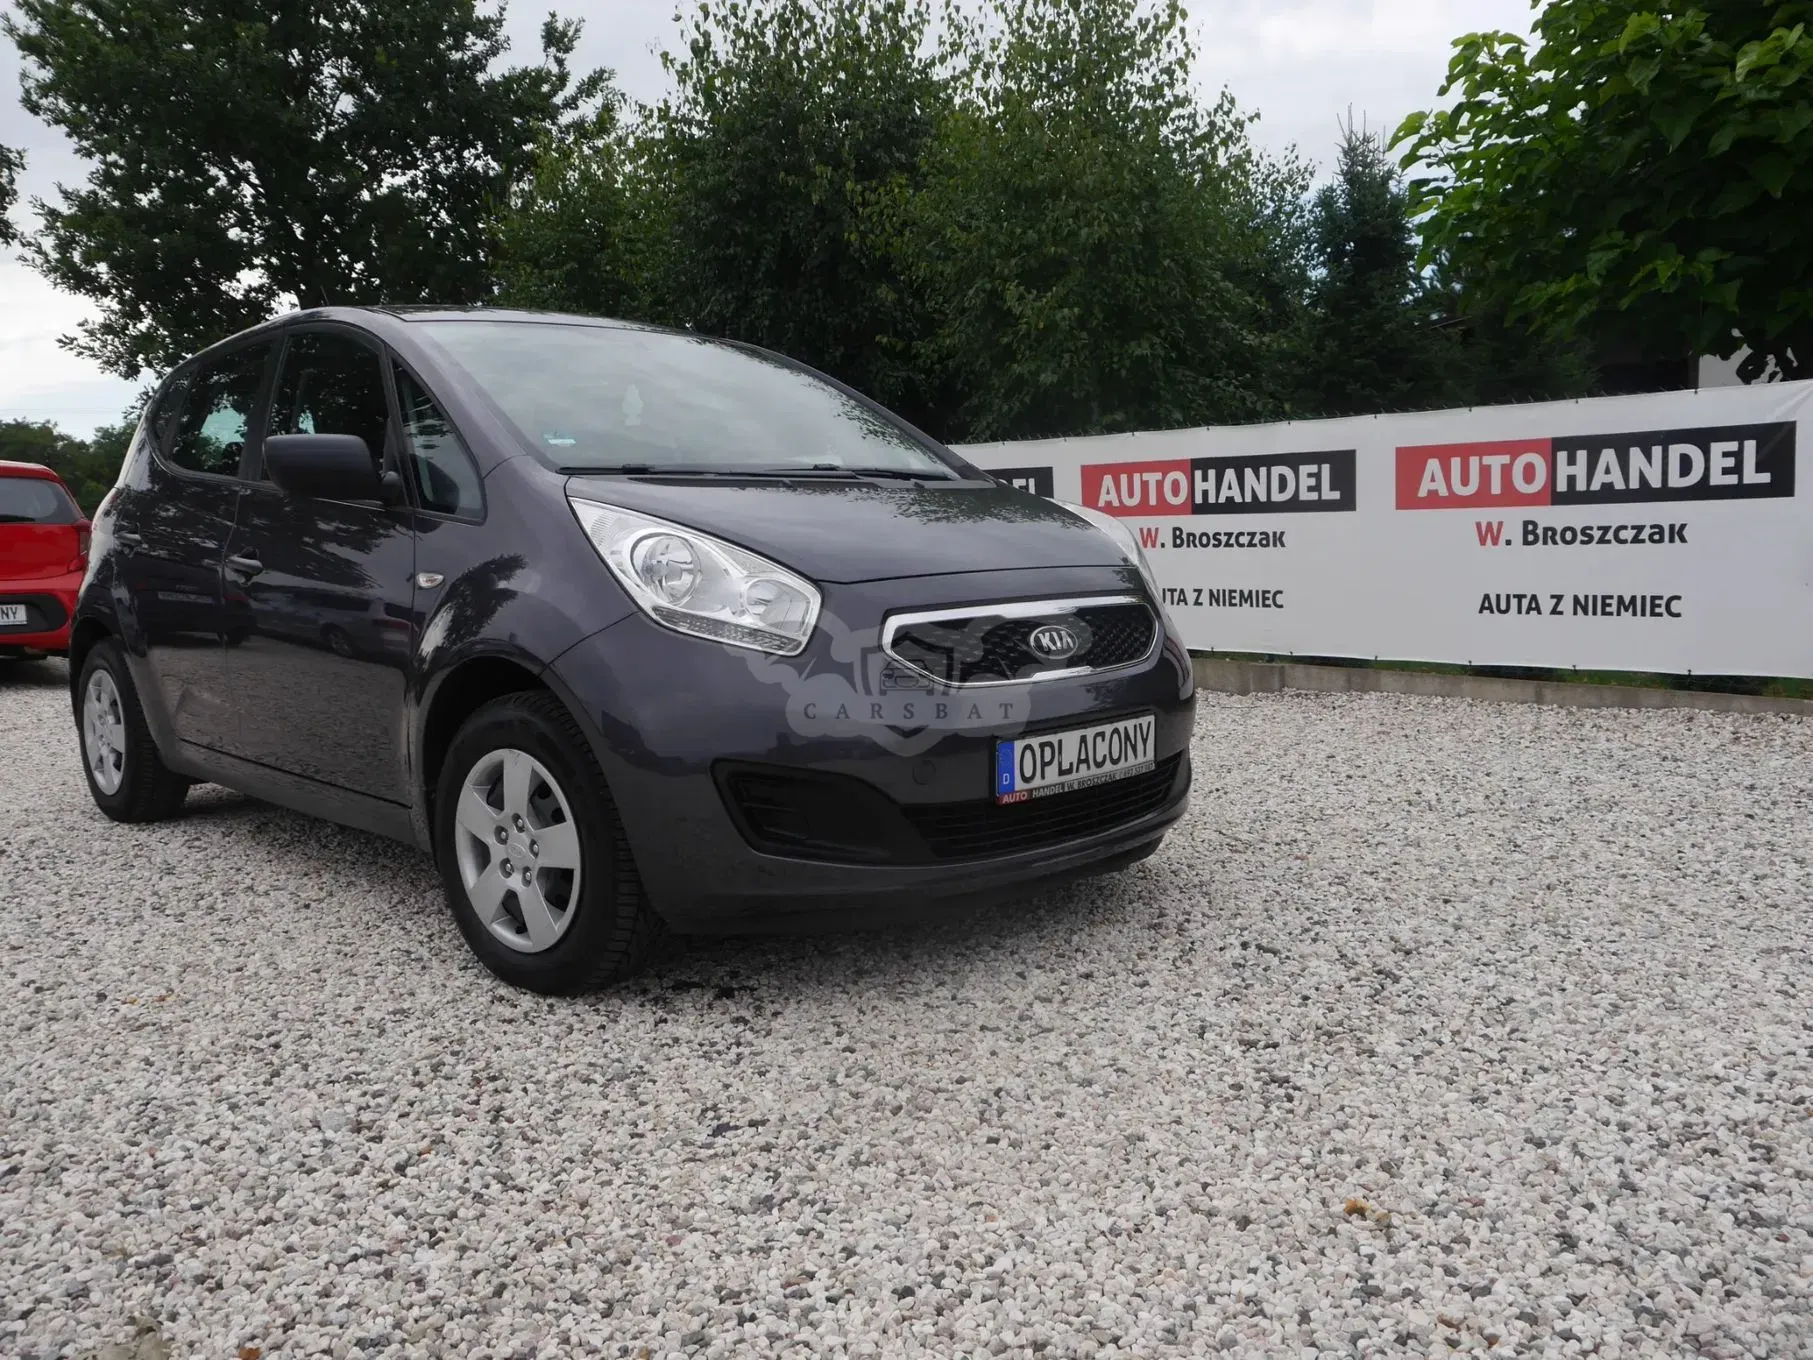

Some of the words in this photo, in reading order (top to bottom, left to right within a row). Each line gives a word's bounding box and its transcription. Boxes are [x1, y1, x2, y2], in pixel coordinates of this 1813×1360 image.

[1139, 527, 1165, 548] W.
[1475, 521, 1512, 546] W.
[1193, 588, 1203, 606] Z
[1209, 589, 1284, 609] NIEMIEC
[1478, 594, 1542, 615] AUTA
[1549, 594, 1564, 616] Z
[1572, 595, 1683, 618] NIEMIEC
[1037, 631, 1074, 651] KIA
[1019, 721, 1152, 784] OPLACONY
[1003, 773, 1010, 784] D
[1002, 791, 1028, 804] AUTO
[1032, 784, 1063, 798] HANDEL
